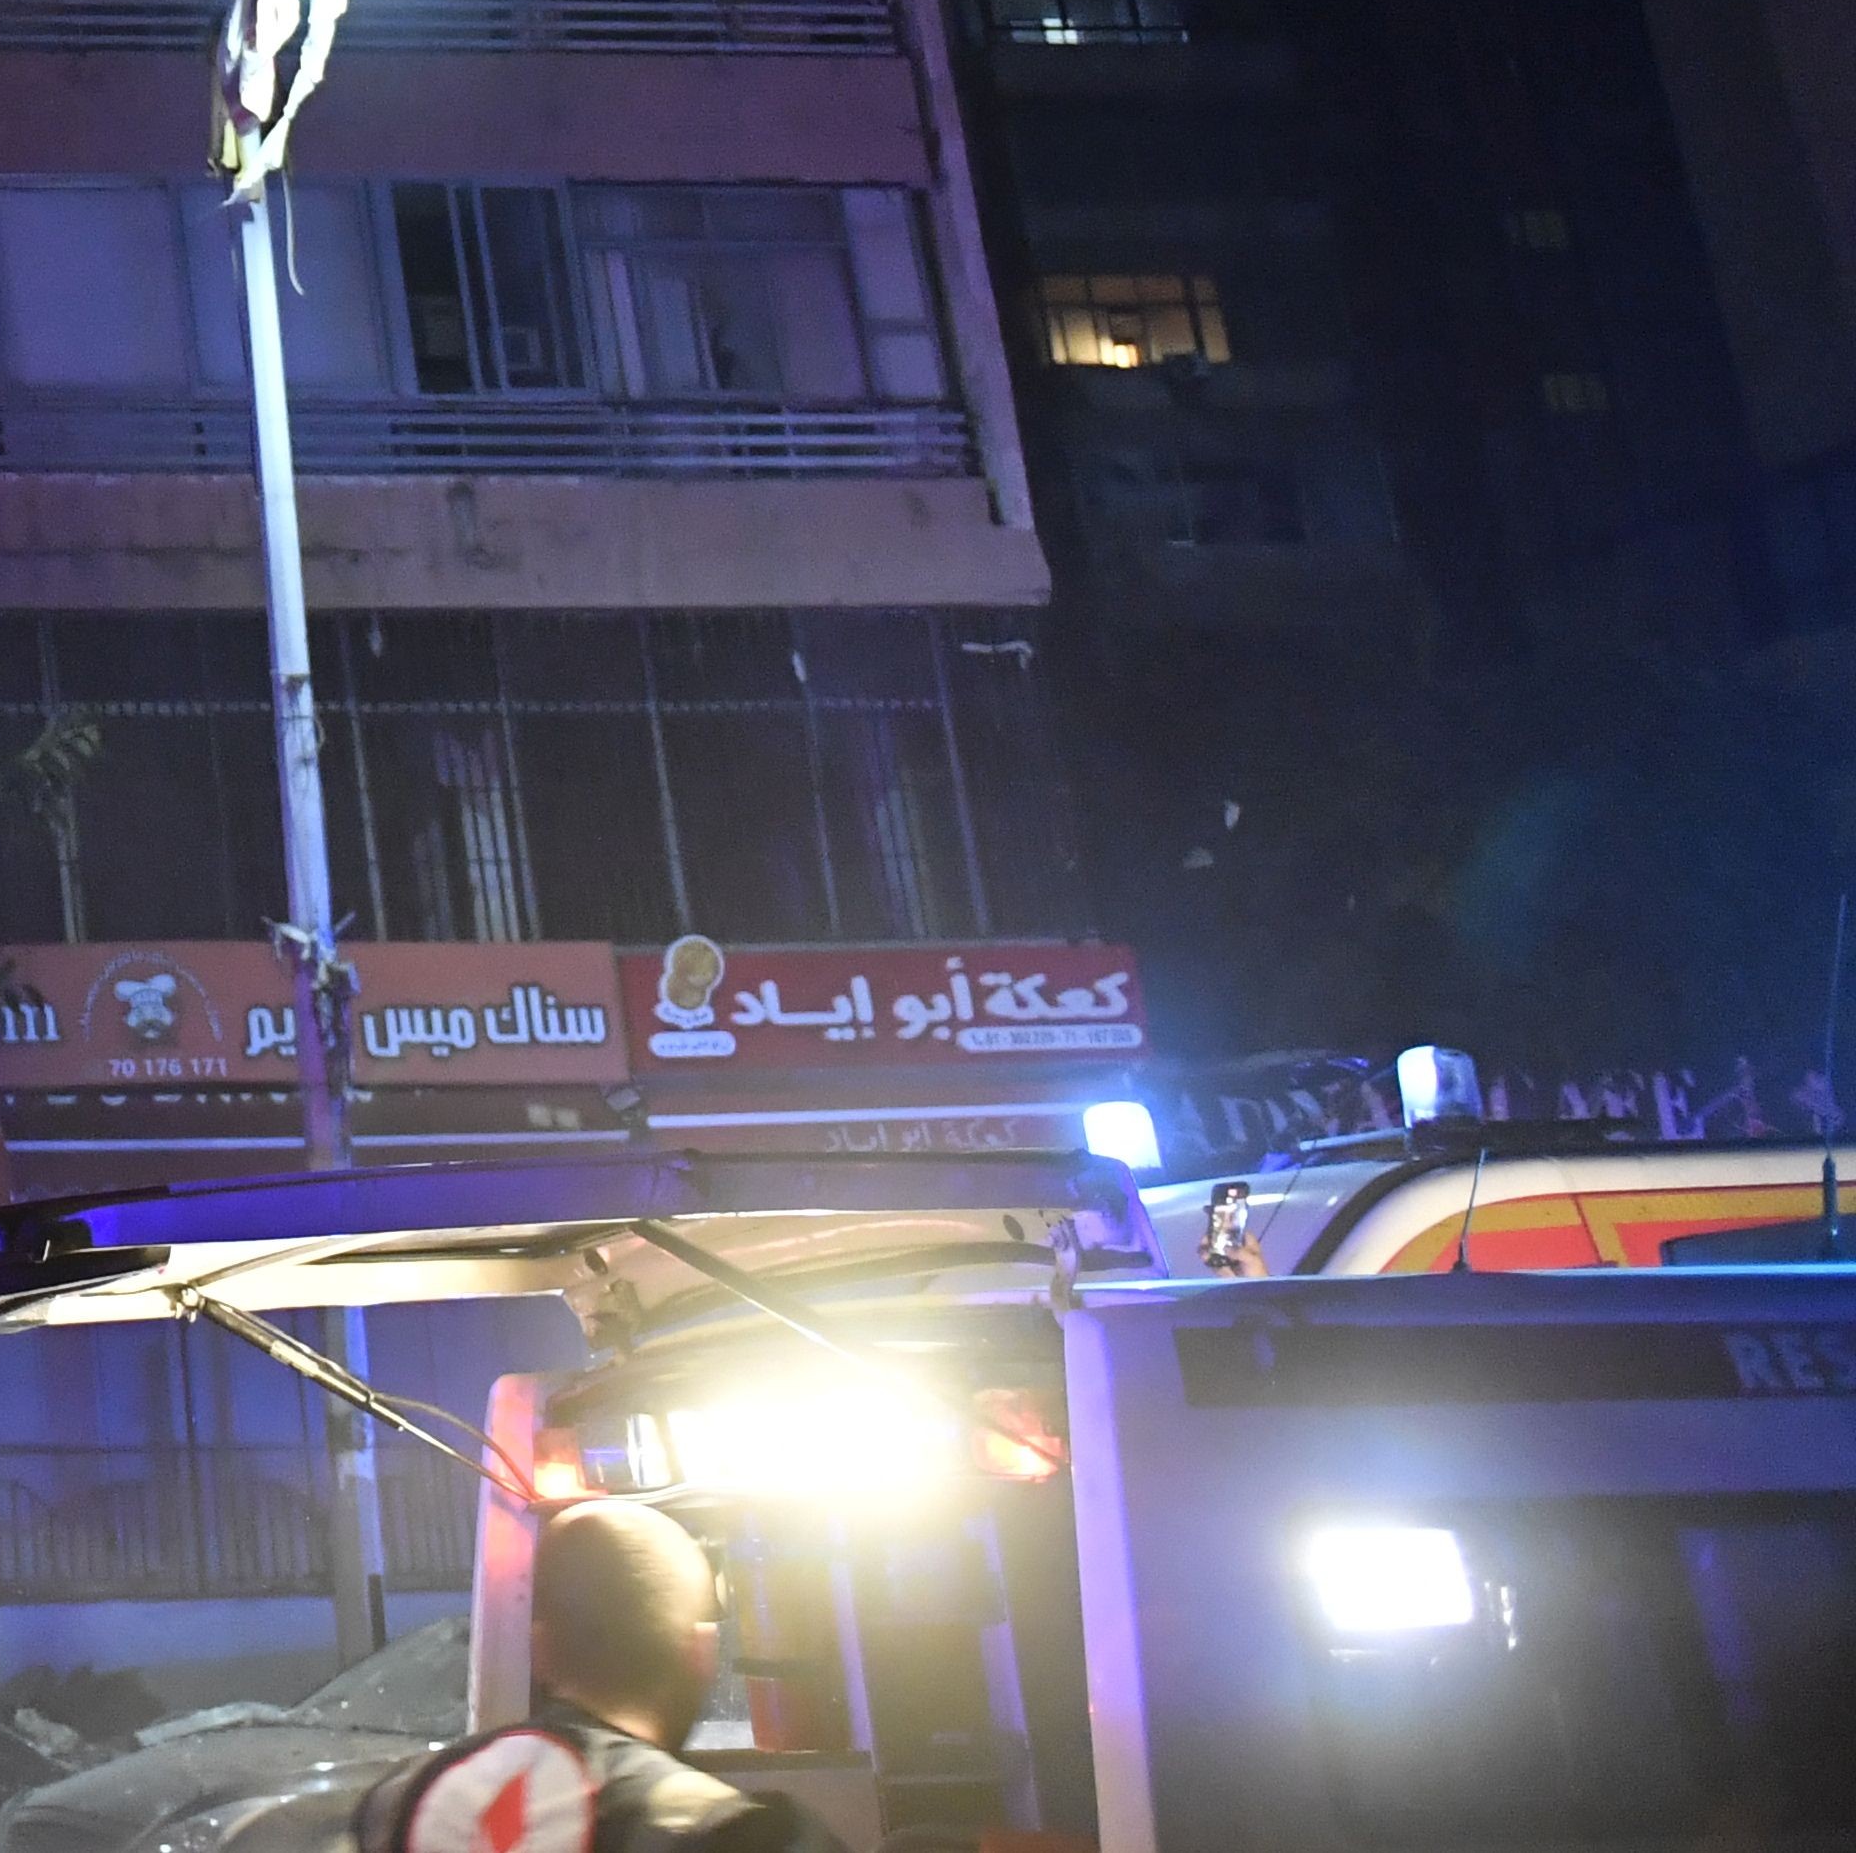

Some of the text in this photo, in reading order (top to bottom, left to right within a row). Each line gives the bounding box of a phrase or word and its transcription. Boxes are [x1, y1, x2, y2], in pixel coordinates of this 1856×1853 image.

[484, 984, 607, 1046] سناك
[978, 969, 1131, 1023] كعكة
[362, 1000, 477, 1058] ميس
[107, 1057, 137, 1078] 70
